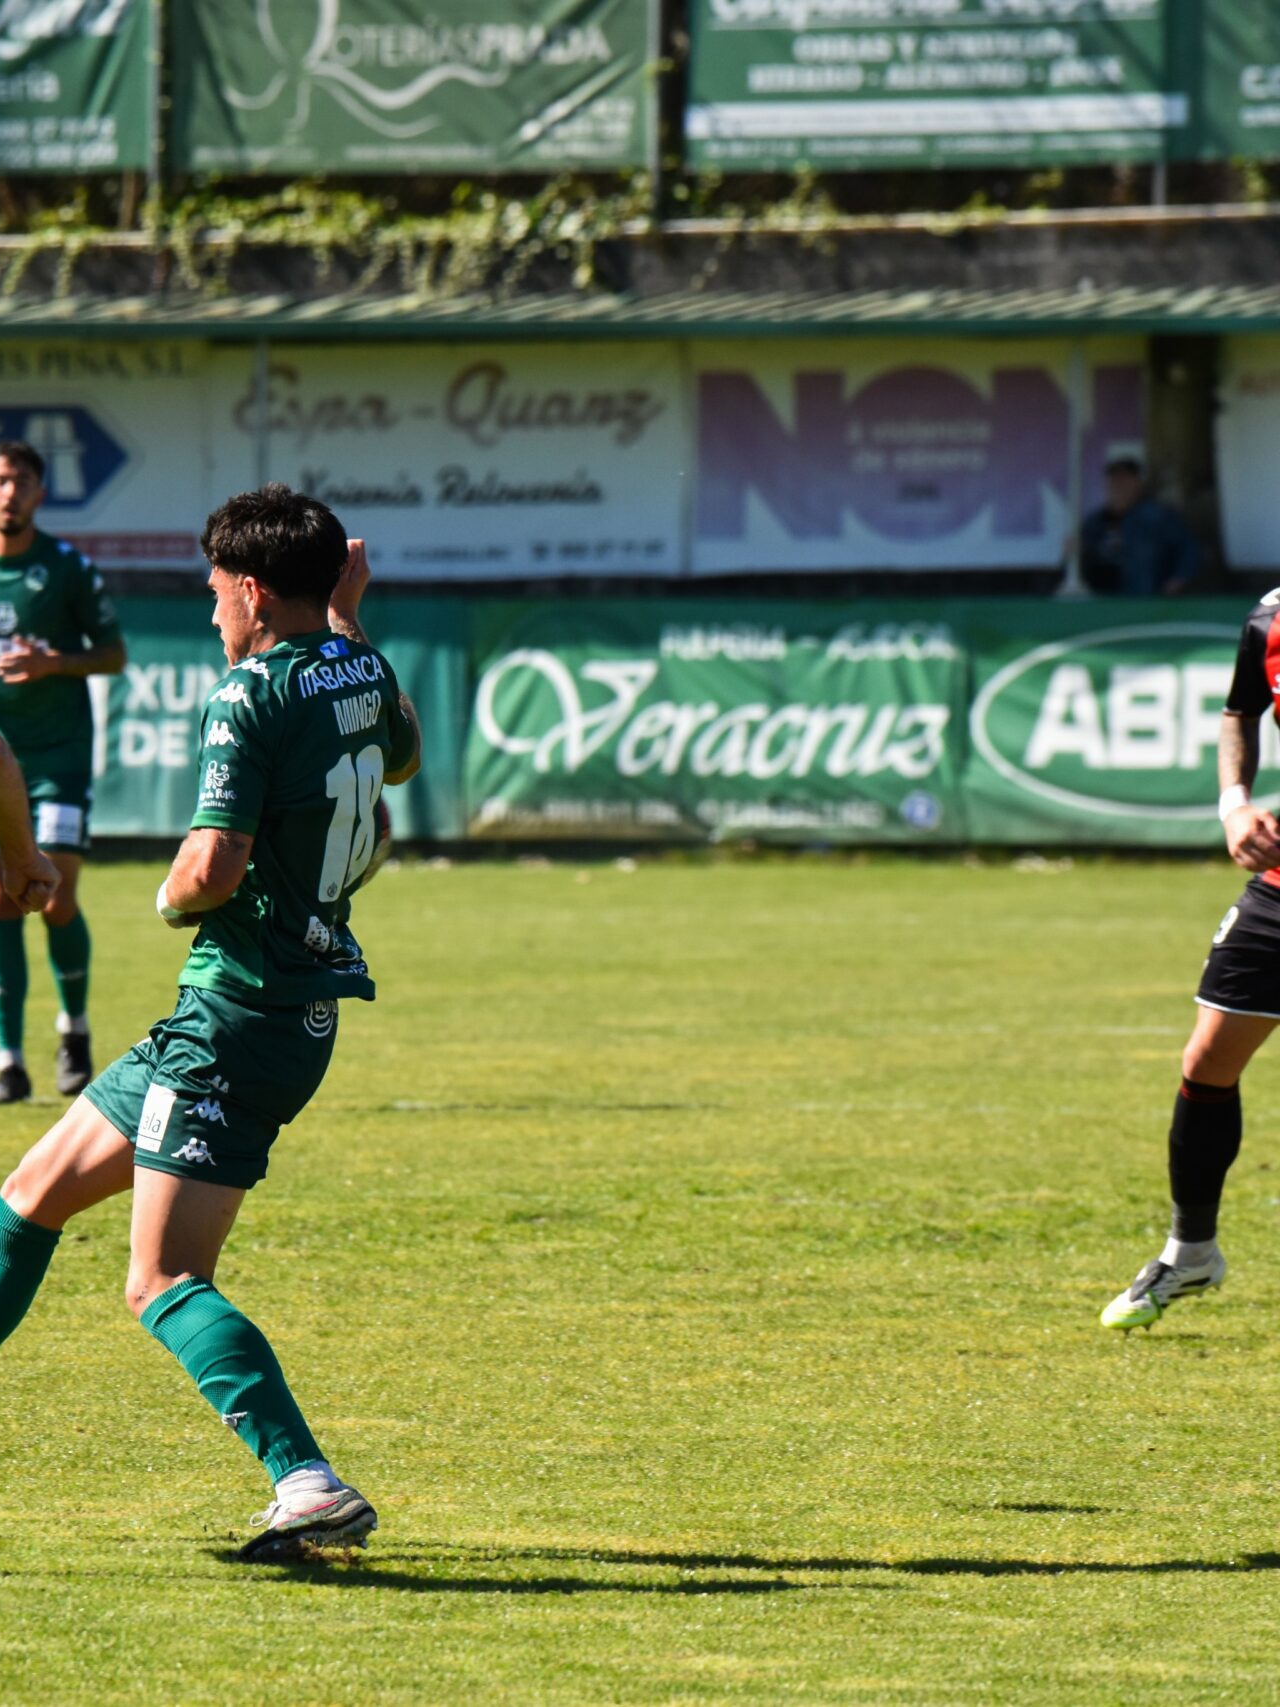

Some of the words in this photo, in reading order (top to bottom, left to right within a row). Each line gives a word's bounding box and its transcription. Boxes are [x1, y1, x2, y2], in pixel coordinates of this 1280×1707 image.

[310, 654, 385, 696] ABANCA
[332, 689, 382, 736] MINGO
[476, 649, 951, 778] Veracruz
[121, 719, 191, 767] DE
[318, 744, 384, 902] 18
